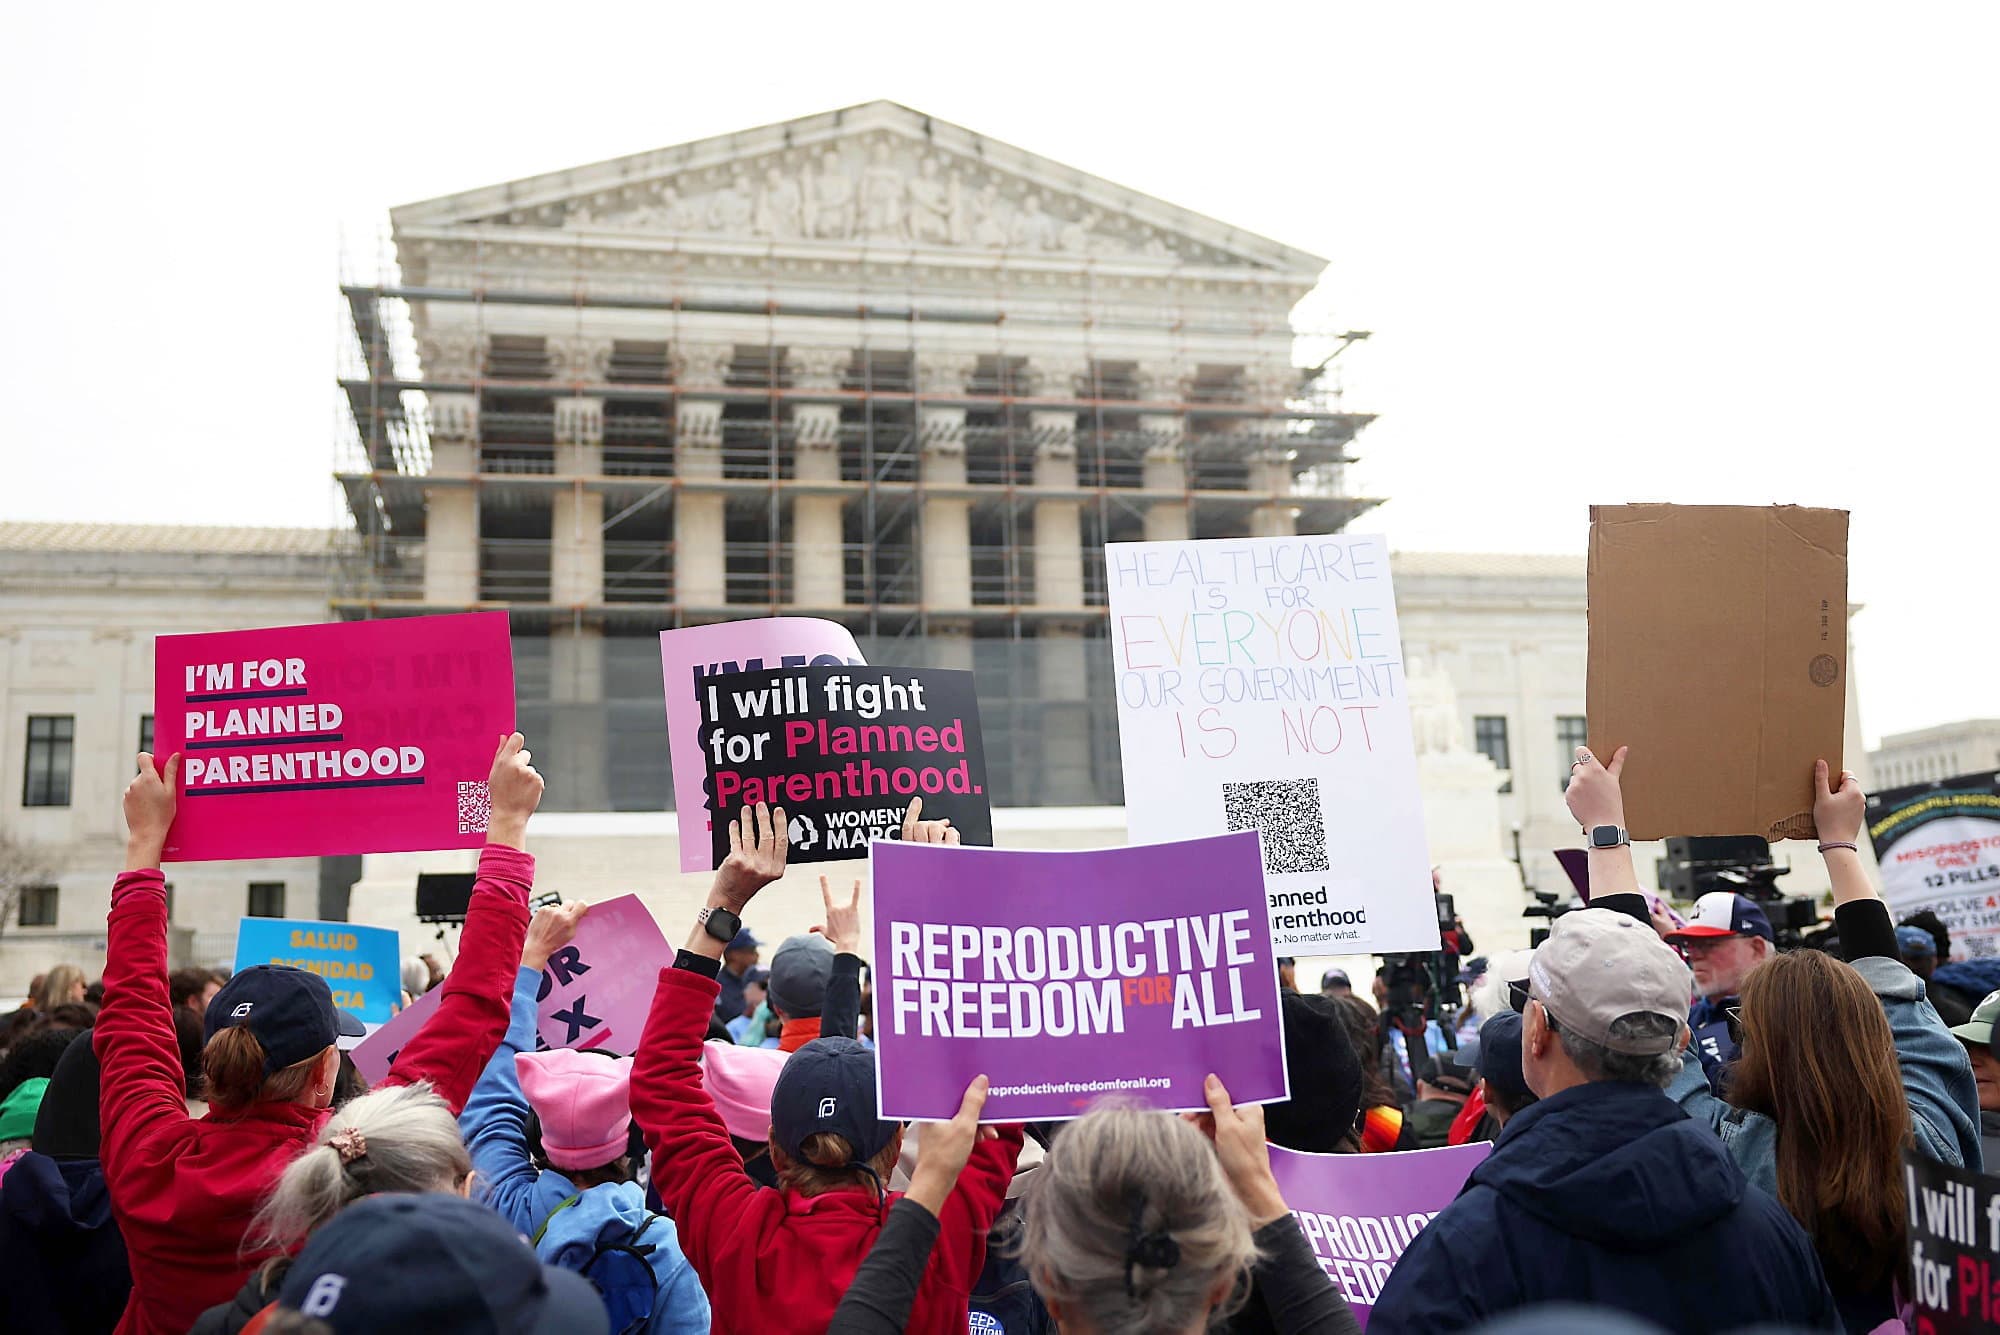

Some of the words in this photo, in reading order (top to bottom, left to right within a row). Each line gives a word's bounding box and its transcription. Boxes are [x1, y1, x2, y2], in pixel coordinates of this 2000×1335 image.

[1115, 542, 1378, 587] HEALTHCARE
[1192, 587, 1228, 610] IS
[1265, 586, 1314, 608] FOR
[1120, 608, 1388, 669] EVERYONE
[185, 662, 233, 693] I'M
[243, 657, 306, 689] FOR
[1121, 670, 1184, 708] OUR
[1199, 662, 1399, 704] GOVERNMENT
[708, 685, 718, 723] I
[732, 676, 808, 719] will
[824, 675, 926, 719] fight
[185, 703, 343, 738] PLANNED
[1176, 707, 1236, 758] IS
[1282, 705, 1378, 755] NOT
[710, 729, 770, 765] for
[785, 718, 966, 758] Planned
[185, 746, 425, 785] PARENTHOOD
[716, 759, 983, 808] Parenthood.
[825, 807, 906, 828] WOMEN'
[826, 825, 902, 850] MARC
[1896, 835, 2000, 863] MISOPROSTO
[1924, 874, 1944, 887] 12
[1948, 865, 2000, 883] PILLS
[1936, 853, 1978, 869] ONLY
[1269, 886, 1328, 908] anned
[1272, 905, 1366, 929] renthood
[289, 929, 358, 951] SALUD
[890, 909, 1254, 982] REPRODUCTIVE
[1283, 934, 1298, 944] No
[1300, 932, 1332, 942] matter
[1334, 929, 1360, 940] what.
[269, 957, 374, 981] NIDAD
[332, 990, 365, 1009] CIA
[892, 978, 1125, 1039] FREEDOM
[1124, 975, 1173, 1006] FOR
[1171, 967, 1262, 1029] ALL
[987, 1077, 1171, 1098] reproductivefreedomforall.org
[1906, 1165, 1918, 1228] I
[1921, 1180, 1975, 1246] will
[1290, 1209, 1440, 1261] PRODU
[1912, 1240, 1951, 1311] for
[968, 1311, 997, 1328] EEP
